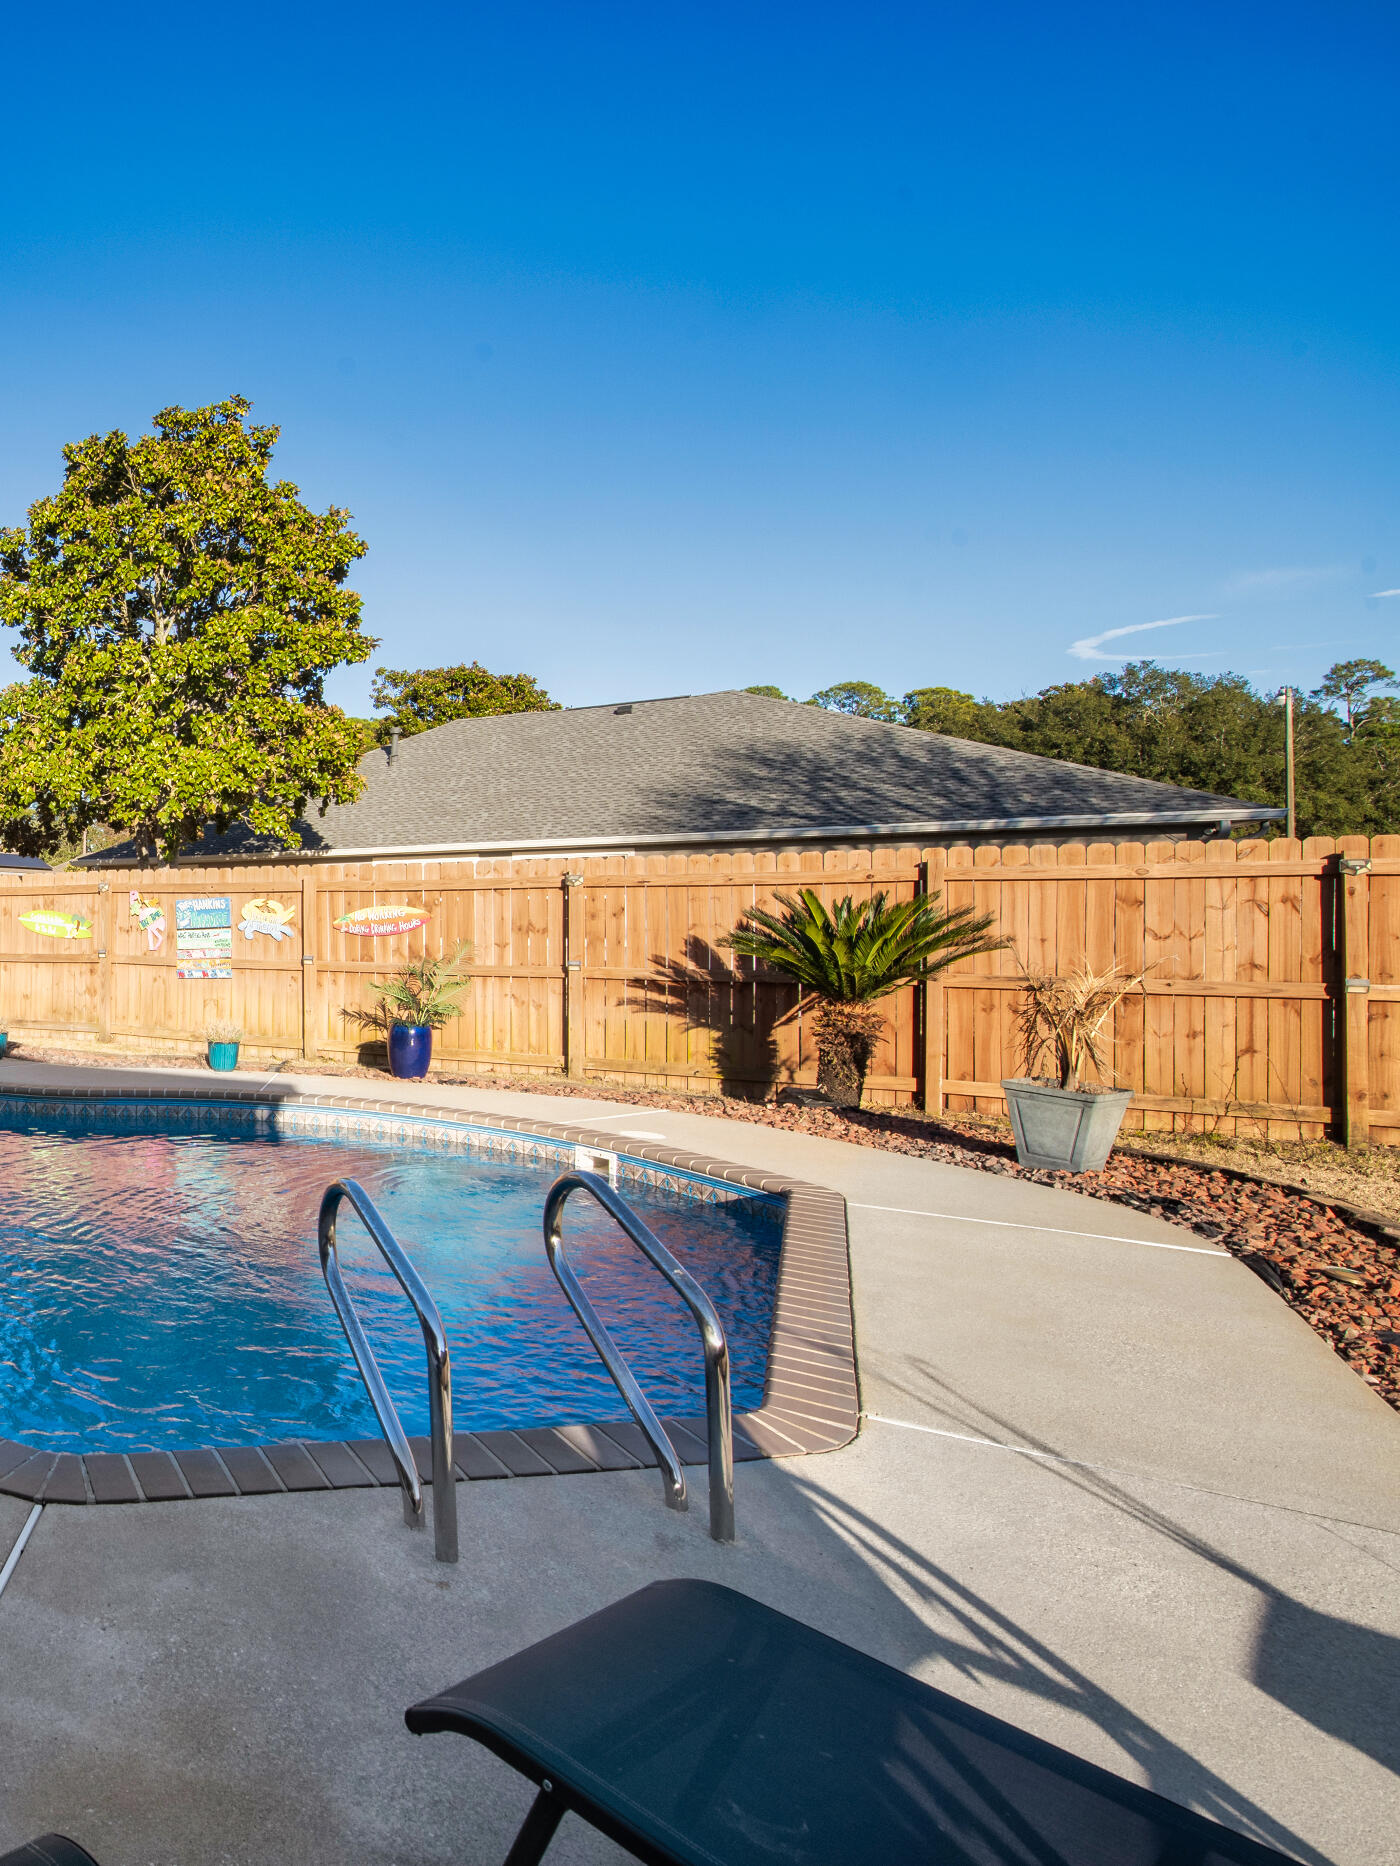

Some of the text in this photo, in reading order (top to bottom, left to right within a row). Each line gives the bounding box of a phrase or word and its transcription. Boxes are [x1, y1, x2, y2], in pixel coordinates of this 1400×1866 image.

[367, 909, 406, 920] WORKING
[370, 922, 397, 934] DRINKING
[398, 918, 422, 932] HOURS
